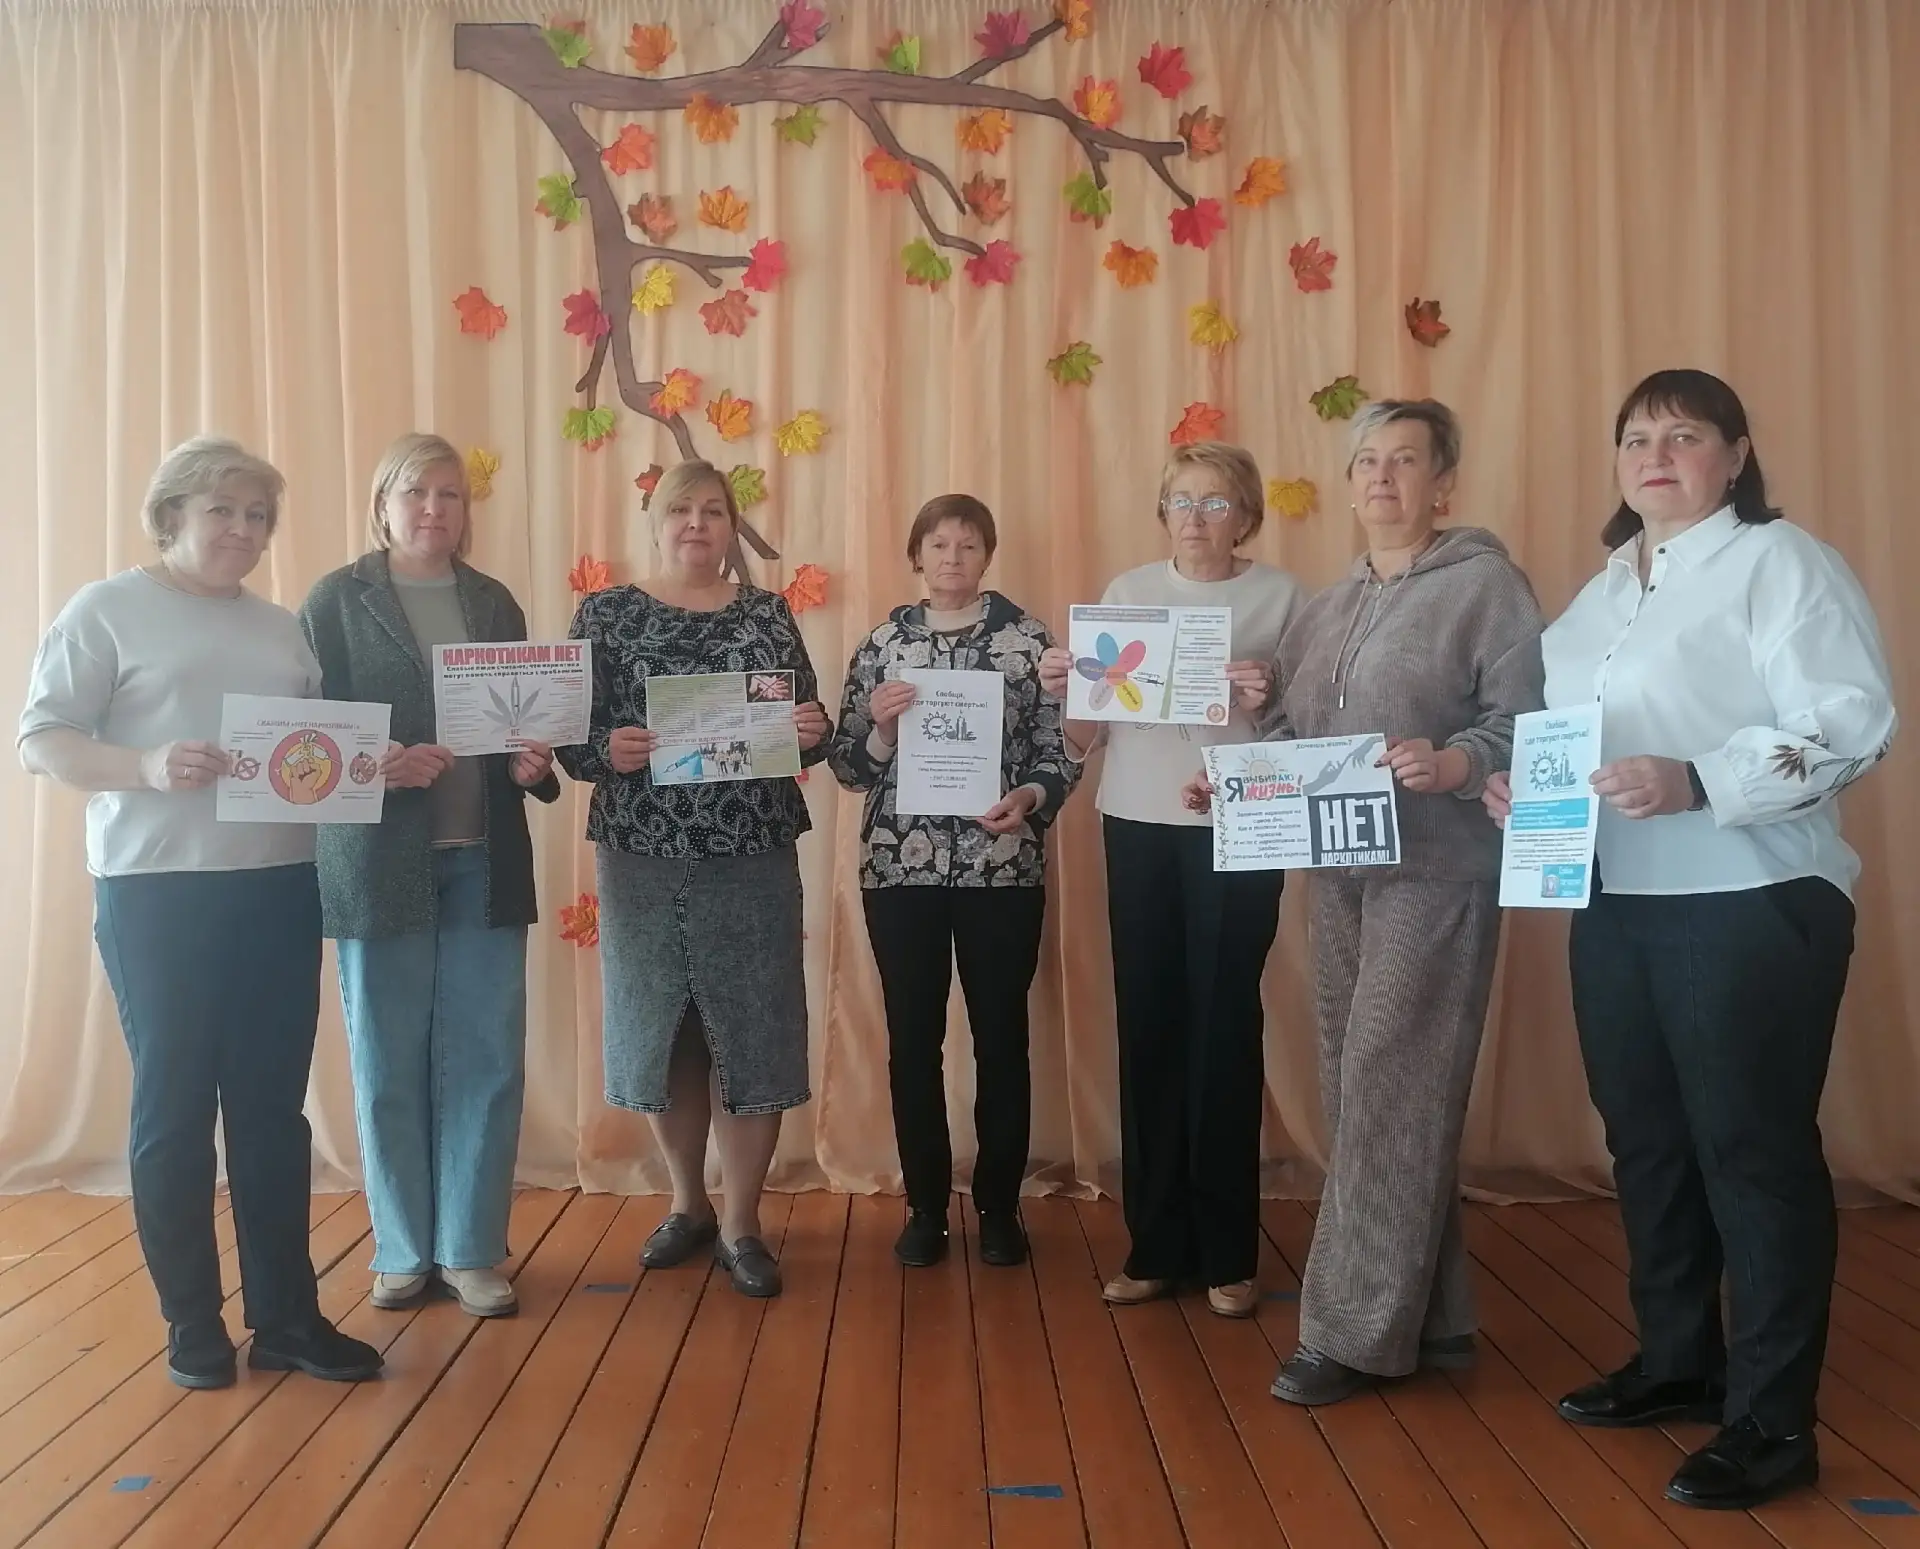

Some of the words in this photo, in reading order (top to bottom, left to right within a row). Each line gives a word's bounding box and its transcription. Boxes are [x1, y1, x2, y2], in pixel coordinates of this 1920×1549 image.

[442, 646, 550, 666] НАРКОТИКАМ
[554, 644, 582, 662] НЕТ
[1225, 777, 1244, 802] Я
[1243, 774, 1295, 784] ВЫБИРАЮ
[1318, 796, 1388, 850] НЕТ
[1321, 849, 1390, 865] НАРКОТИКАМ!
